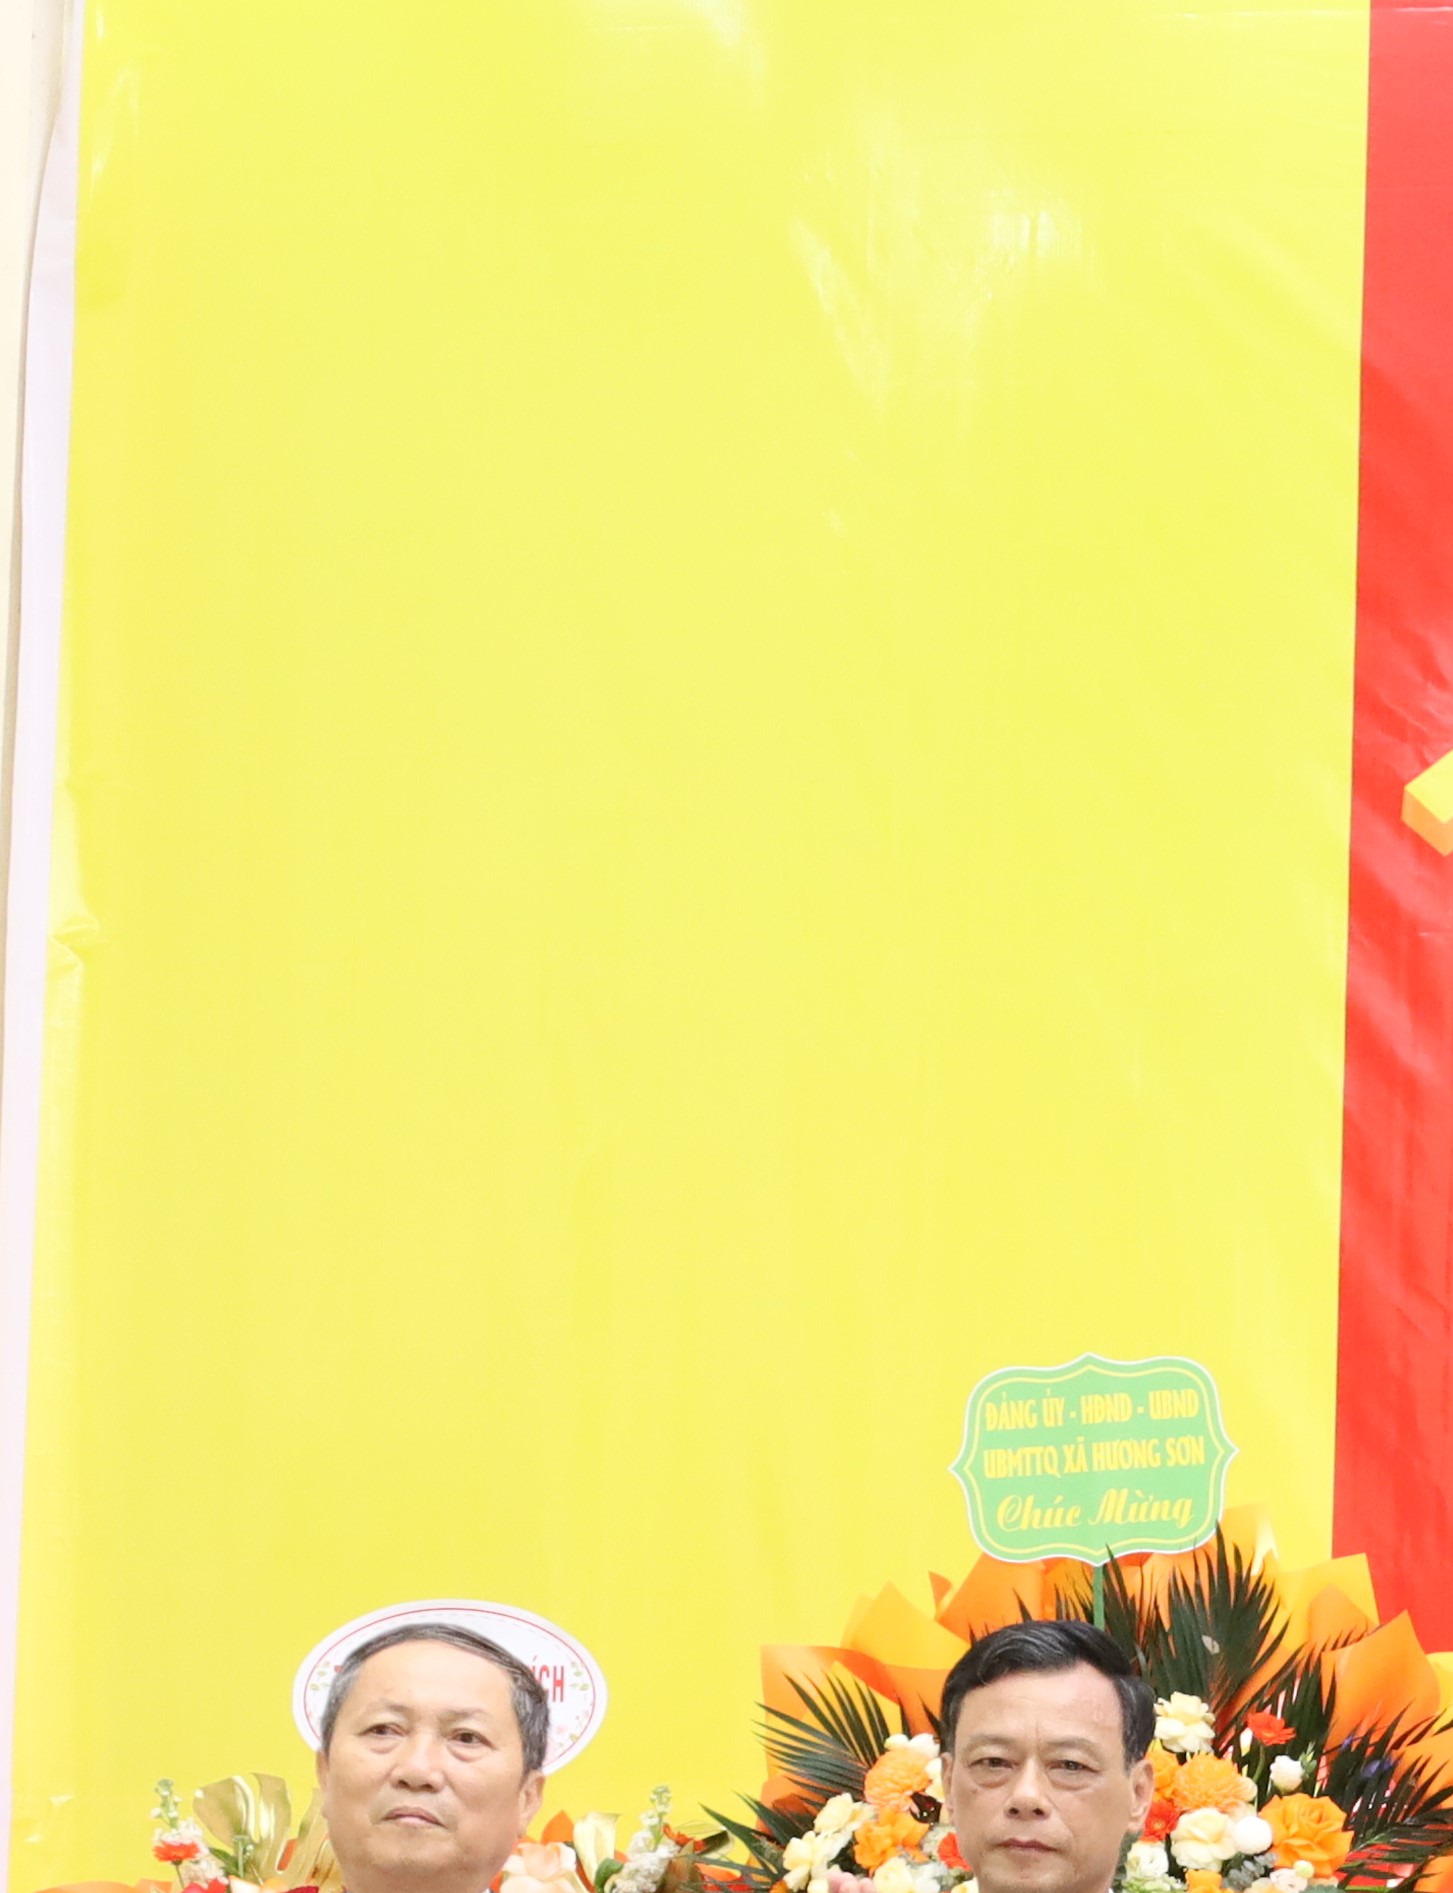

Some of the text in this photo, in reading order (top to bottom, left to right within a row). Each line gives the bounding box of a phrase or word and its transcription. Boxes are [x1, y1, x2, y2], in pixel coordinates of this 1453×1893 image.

[985, 1391, 1038, 1432] ĐẢNG
[1042, 1388, 1066, 1427] ỦY
[1148, 1387, 1200, 1420] UBND
[983, 1435, 1205, 1479] UBMTTQ XÃ HƯƠNG SƠN
[996, 1488, 1195, 1532] Chúc Mừng
